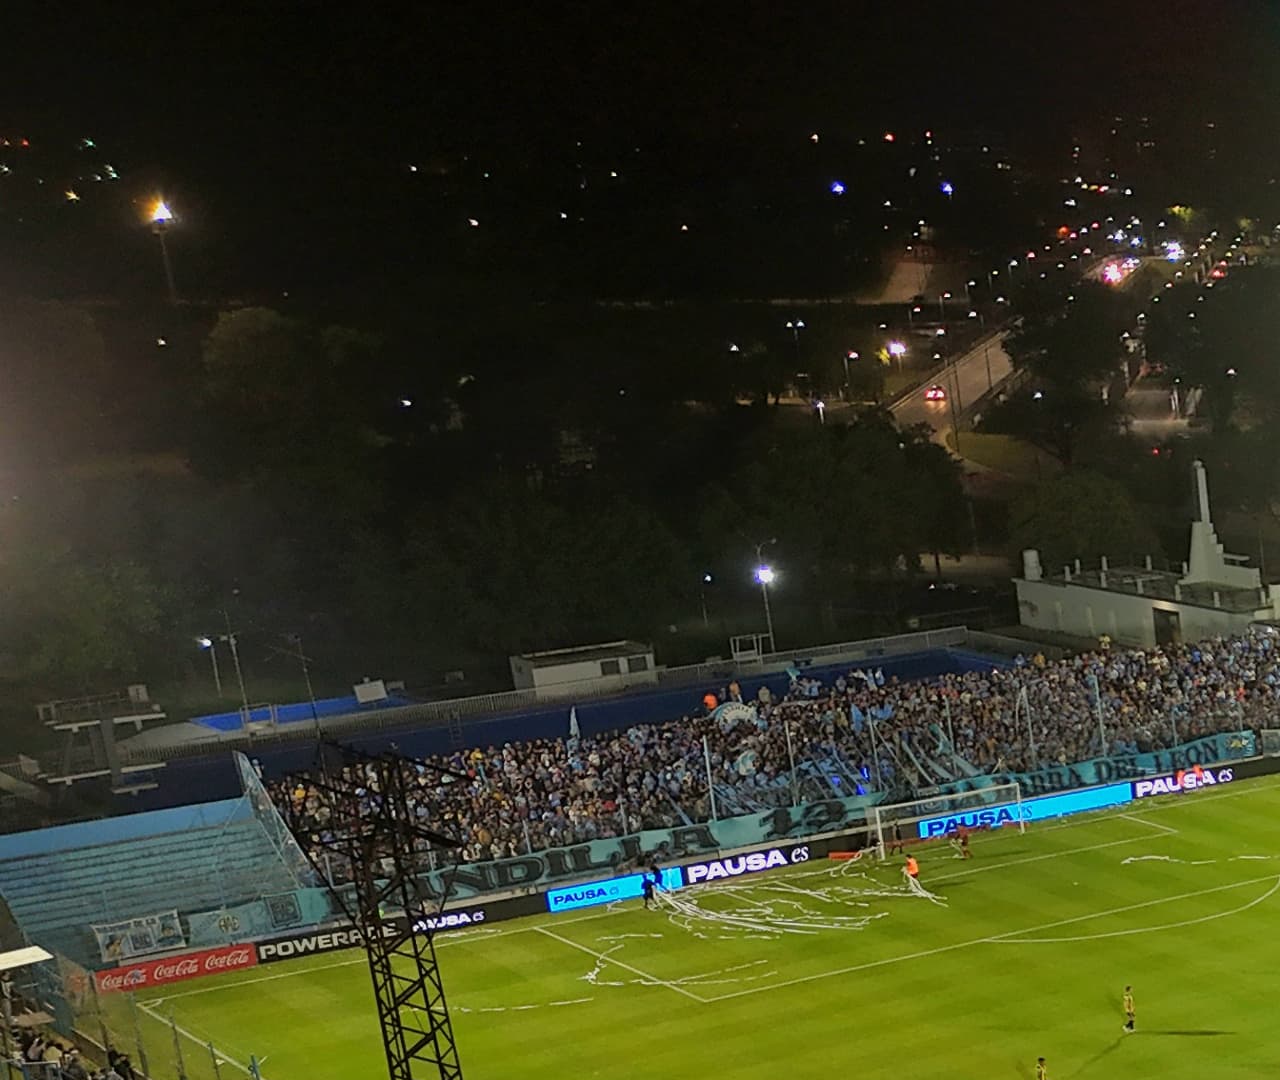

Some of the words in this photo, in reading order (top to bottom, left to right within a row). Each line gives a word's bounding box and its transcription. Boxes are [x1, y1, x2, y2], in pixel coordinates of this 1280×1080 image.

[1094, 756, 1144, 784] DEL
[1154, 740, 1220, 774] LEON
[1136, 771, 1217, 798] PAUSA
[1218, 768, 1234, 783] es
[926, 807, 1015, 839] PAUSA
[687, 850, 788, 884] PAUSA
[790, 846, 809, 864] es
[553, 888, 607, 906] PAUSA
[154, 958, 198, 981] Coca-Cola
[205, 948, 249, 970] Coca-Cola
